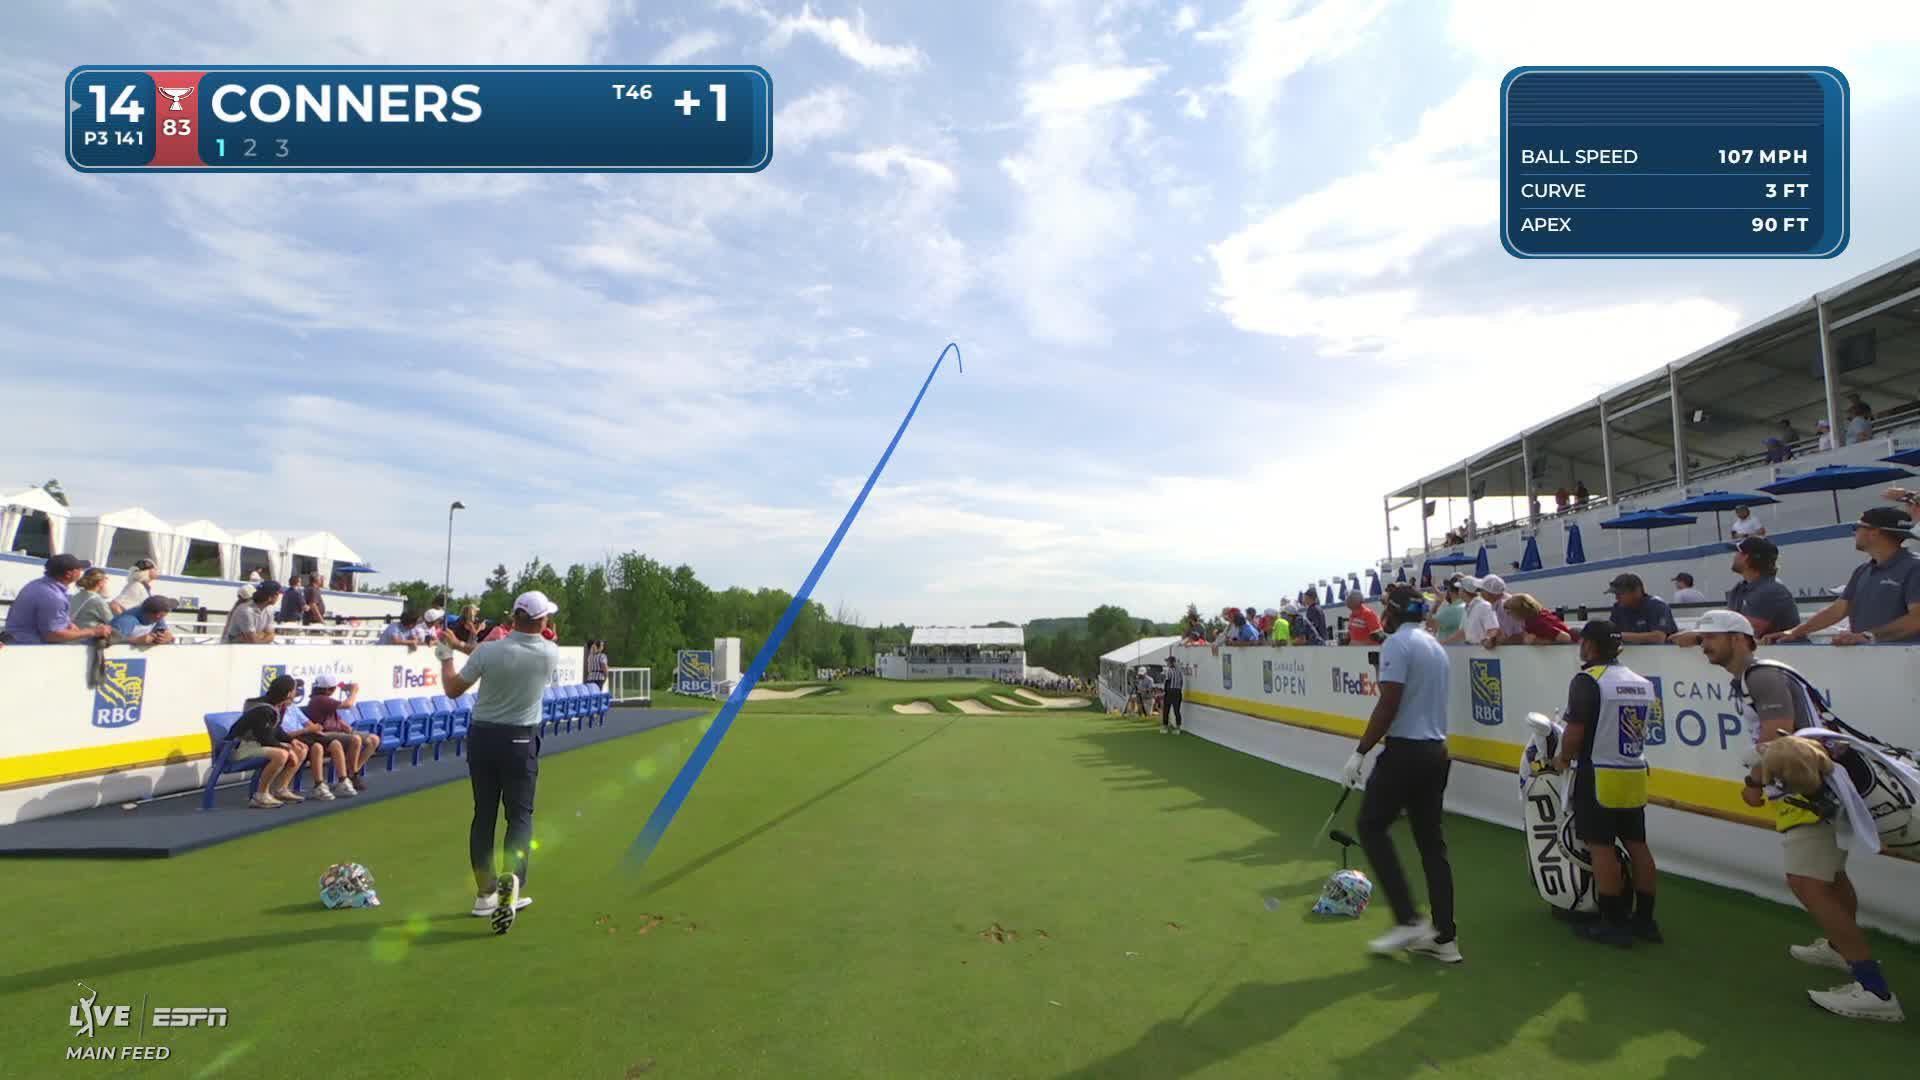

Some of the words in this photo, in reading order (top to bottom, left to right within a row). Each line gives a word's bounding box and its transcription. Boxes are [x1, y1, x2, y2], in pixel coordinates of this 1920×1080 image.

[404, 667, 438, 688] FedEx
[681, 680, 709, 691] RBC
[1275, 674, 1306, 697] OPEN
[1343, 672, 1377, 697] FedEx
[97, 706, 138, 724] RBC
[1475, 705, 1501, 722] RBC
[1528, 794, 1566, 896] PING
